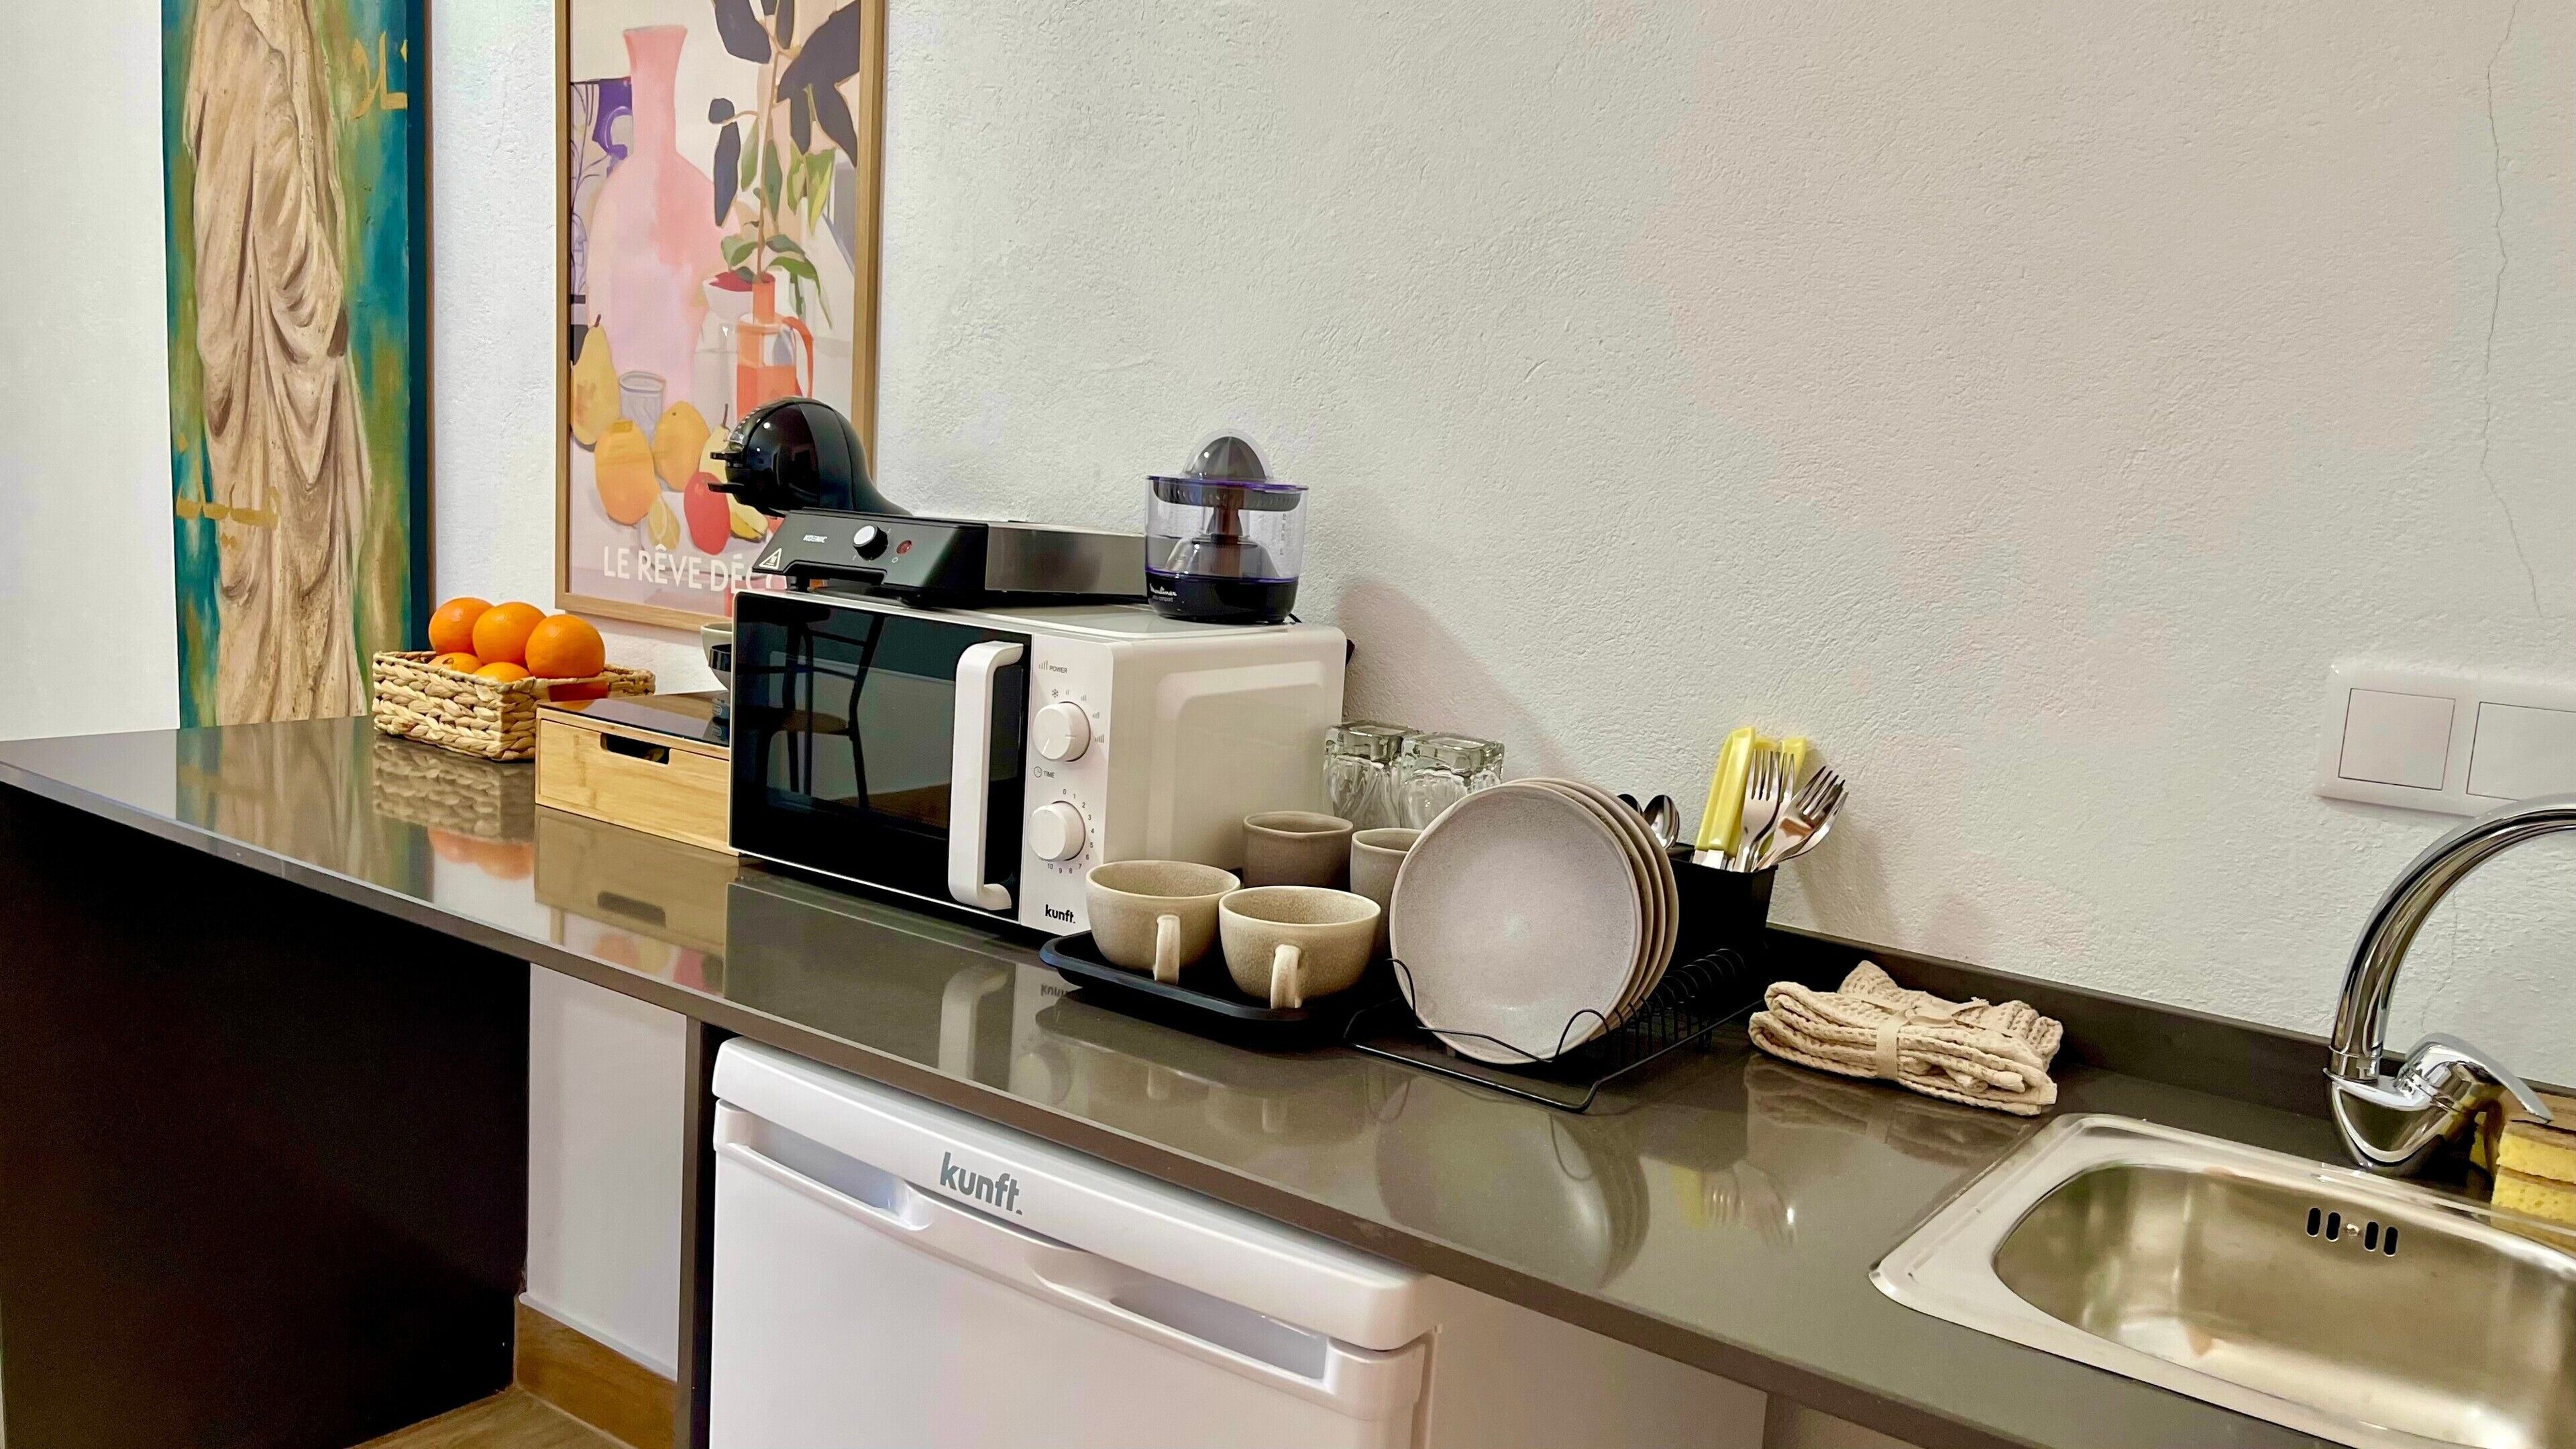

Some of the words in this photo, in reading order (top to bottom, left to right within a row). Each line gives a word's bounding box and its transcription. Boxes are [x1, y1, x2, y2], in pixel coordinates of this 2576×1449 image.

[604, 545, 631, 580] LE
[637, 543, 702, 590] RÊVE
[1049, 665, 1068, 674] POWER
[1044, 770, 1055, 779] TIME
[1045, 904, 1076, 924] kunft.
[940, 1151, 1023, 1216] kunft.
